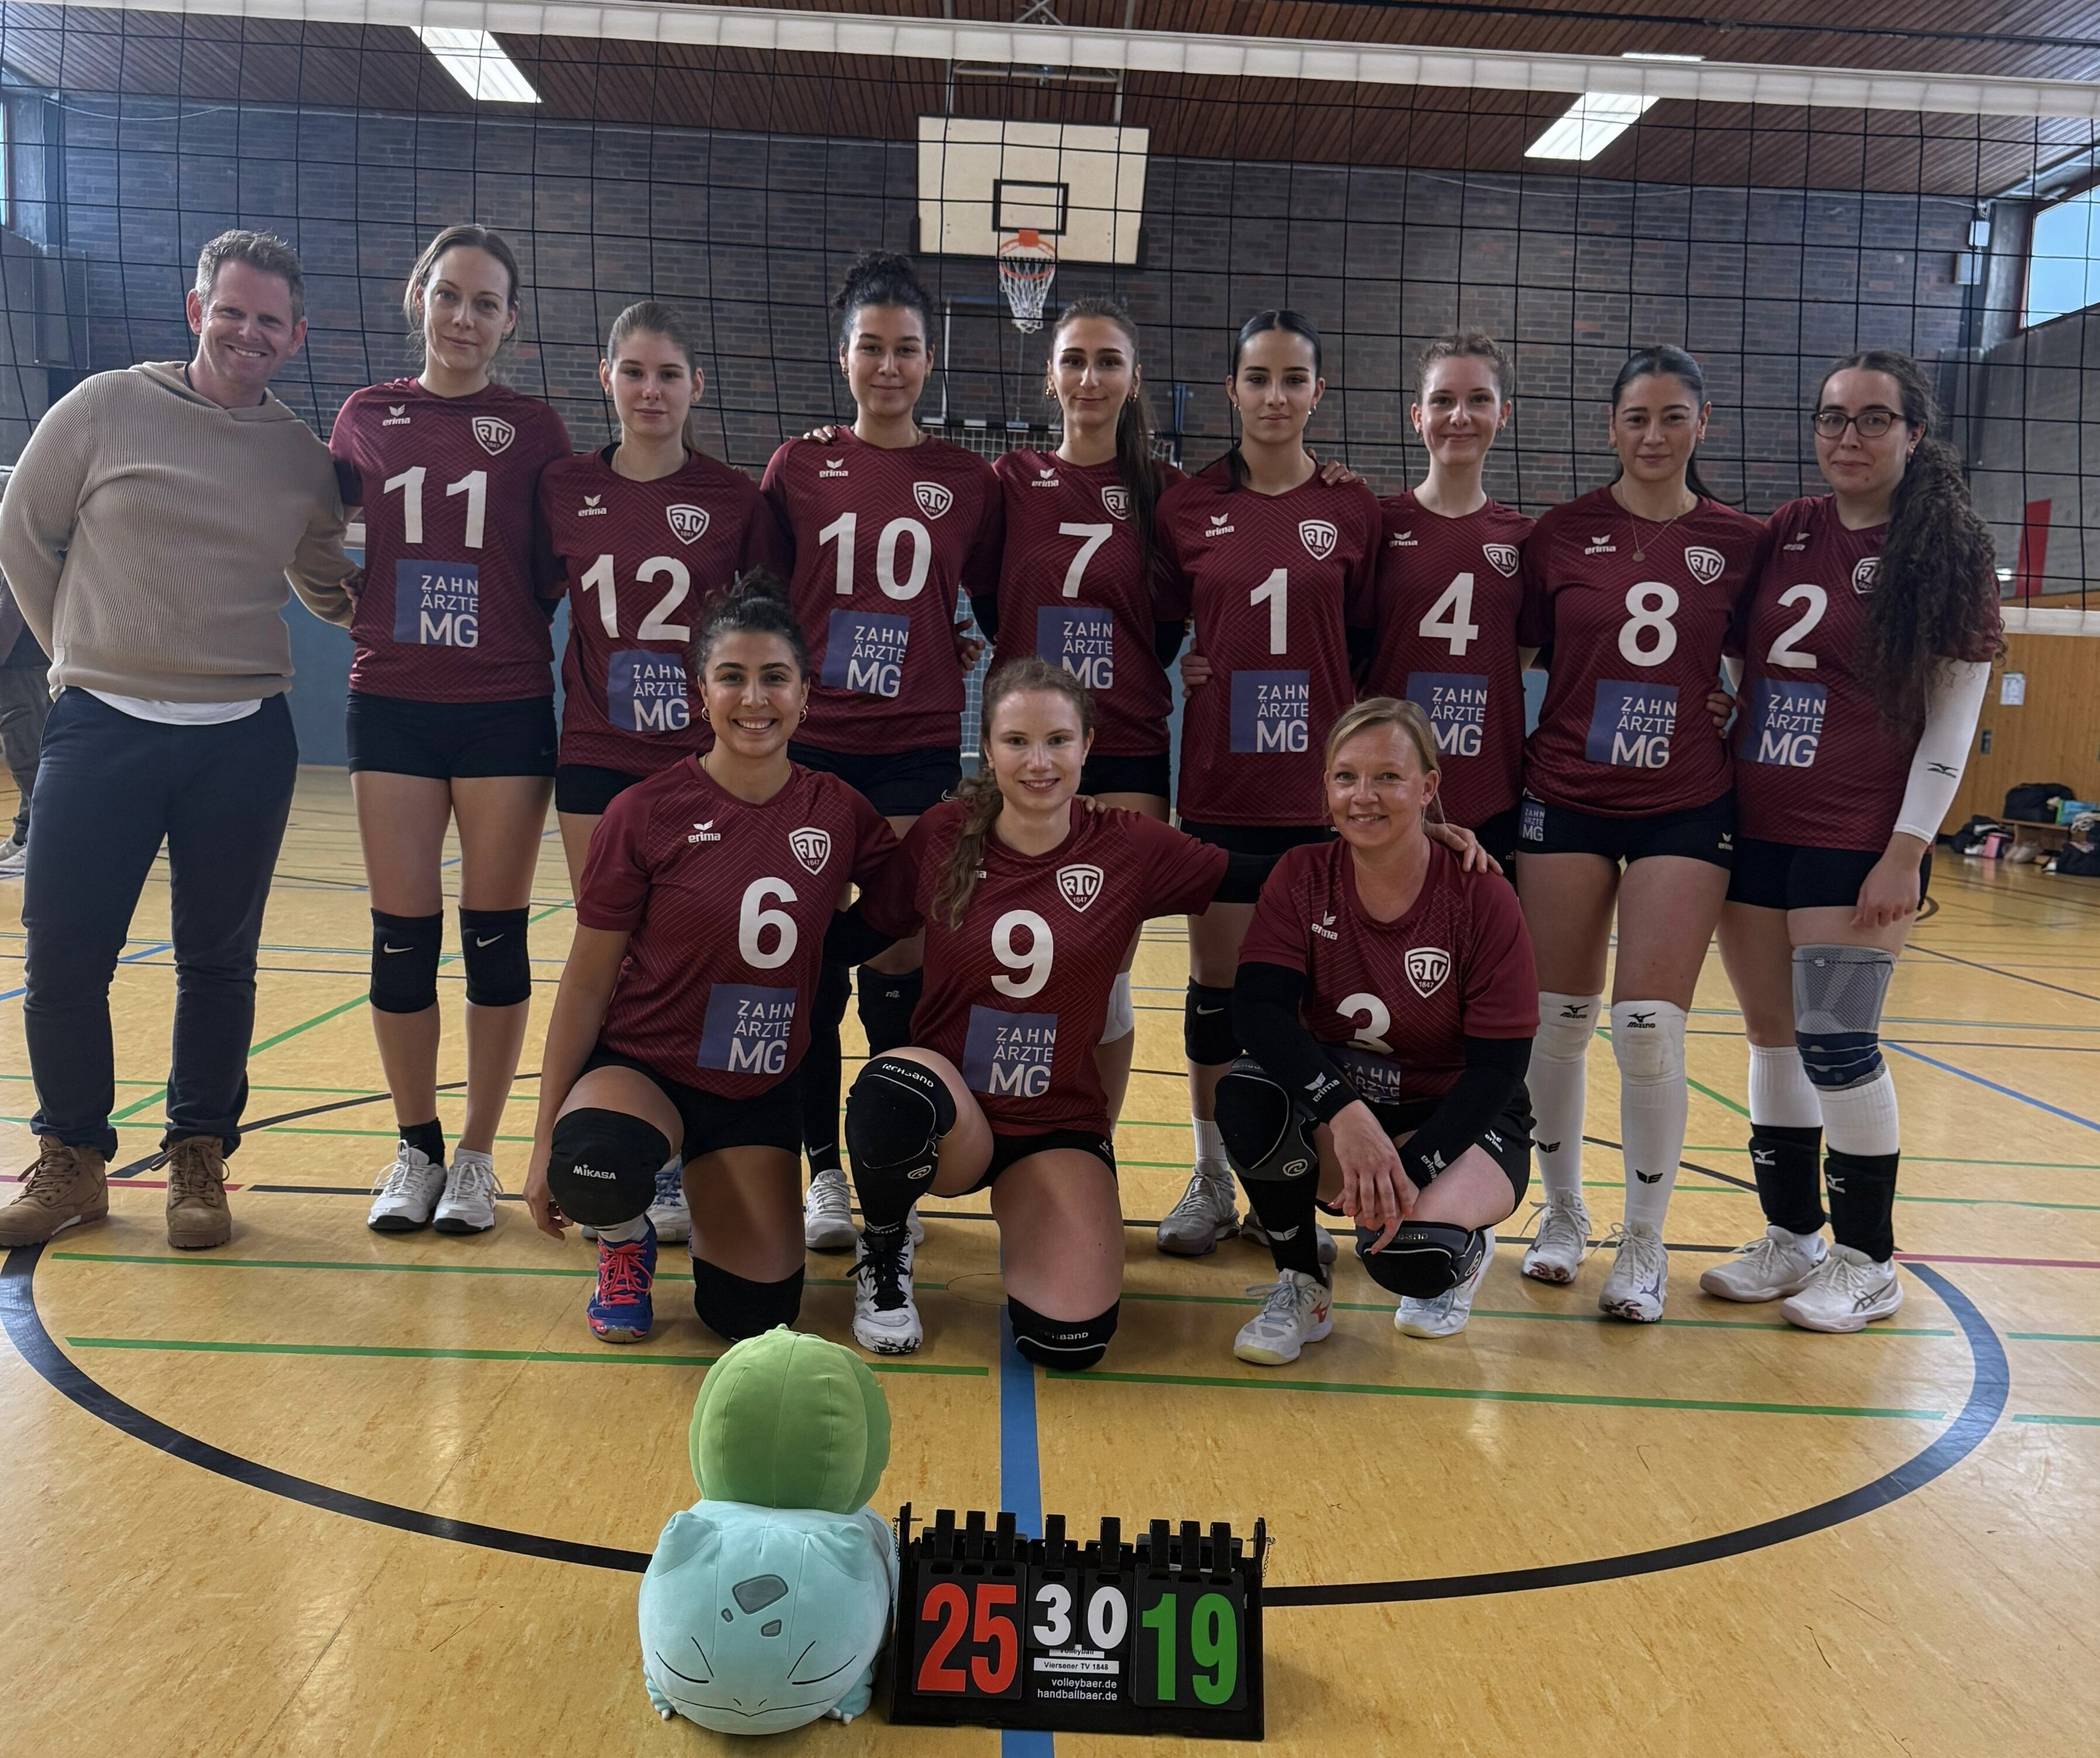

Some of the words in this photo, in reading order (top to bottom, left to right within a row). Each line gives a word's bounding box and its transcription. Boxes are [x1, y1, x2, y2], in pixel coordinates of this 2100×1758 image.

[382, 417, 411, 426] erima
[477, 420, 511, 444] RTV
[819, 469, 849, 478] erima
[1031, 479, 1059, 488] erima
[384, 466, 488, 549] 11
[917, 485, 948, 511] RTV
[578, 507, 607, 517] erima
[672, 508, 705, 533] RTV
[1205, 525, 1235, 538] erima
[1303, 523, 1334, 549] RTV
[819, 512, 932, 600] 10
[1058, 522, 1113, 599] 7
[1584, 545, 1616, 555] erima
[1689, 551, 1721, 576] RTV
[421, 575, 479, 596] ZAHN
[420, 591, 479, 613] ÄRZTE
[581, 554, 690, 643] 12
[1250, 567, 1288, 655] 1
[1418, 572, 1479, 656] 4
[420, 611, 479, 648] MG
[854, 625, 909, 646] ZAHN
[1063, 621, 1113, 637] ZAHN
[1618, 581, 1679, 667] 8
[1766, 584, 1828, 669] 2
[852, 641, 906, 664] ÄRZTE
[1063, 636, 1113, 655] ÄRZTE
[632, 664, 687, 680] ZAHN
[847, 659, 901, 698] MG
[1062, 656, 1113, 689] MG
[632, 675, 688, 697] ÄRZTE
[1257, 685, 1310, 700] ZAHN
[1432, 687, 1487, 704] ZAHN
[633, 698, 690, 732] MG
[1257, 699, 1309, 718] ÄRZTE
[1431, 703, 1486, 723] ÄRZTE
[1621, 696, 1677, 717] ZAHN
[1767, 694, 1826, 715] ZAHN
[1617, 711, 1675, 735] ÄRZTE
[1765, 708, 1823, 733] ÄRZTE
[1256, 719, 1309, 753] MG
[1430, 721, 1483, 757] MG
[1611, 732, 1670, 769] MG
[1757, 730, 1818, 768] MG
[1525, 807, 1545, 818] ZAHN
[688, 832, 721, 843] erima
[1522, 824, 1544, 841] MG
[794, 834, 826, 859] RTV
[1062, 869, 1099, 896] RTV
[739, 876, 798, 970] 6
[991, 909, 1054, 999] 9
[1408, 952, 1448, 981] RTV
[1418, 981, 1434, 989] 1847
[737, 1000, 795, 1019] ZAHN
[734, 1015, 791, 1038] ÄRZTE
[995, 1027, 1056, 1044] ZAHN
[1335, 992, 1394, 1055] 3
[727, 1037, 787, 1074] MG
[993, 1041, 1053, 1063] ÄRZTE
[988, 1062, 1051, 1098] MG
[1312, 1078, 1340, 1102] erima
[1032, 1583, 1072, 1646] 3
[1087, 1586, 1128, 1650] 0
[917, 1582, 1018, 1693] 25
[1142, 1592, 1238, 1705] 19
[1044, 1661, 1079, 1669] Viersener
[1037, 1688, 1118, 1701] handballbaer.de
[1051, 1677, 1118, 1689] volleybaer.de
